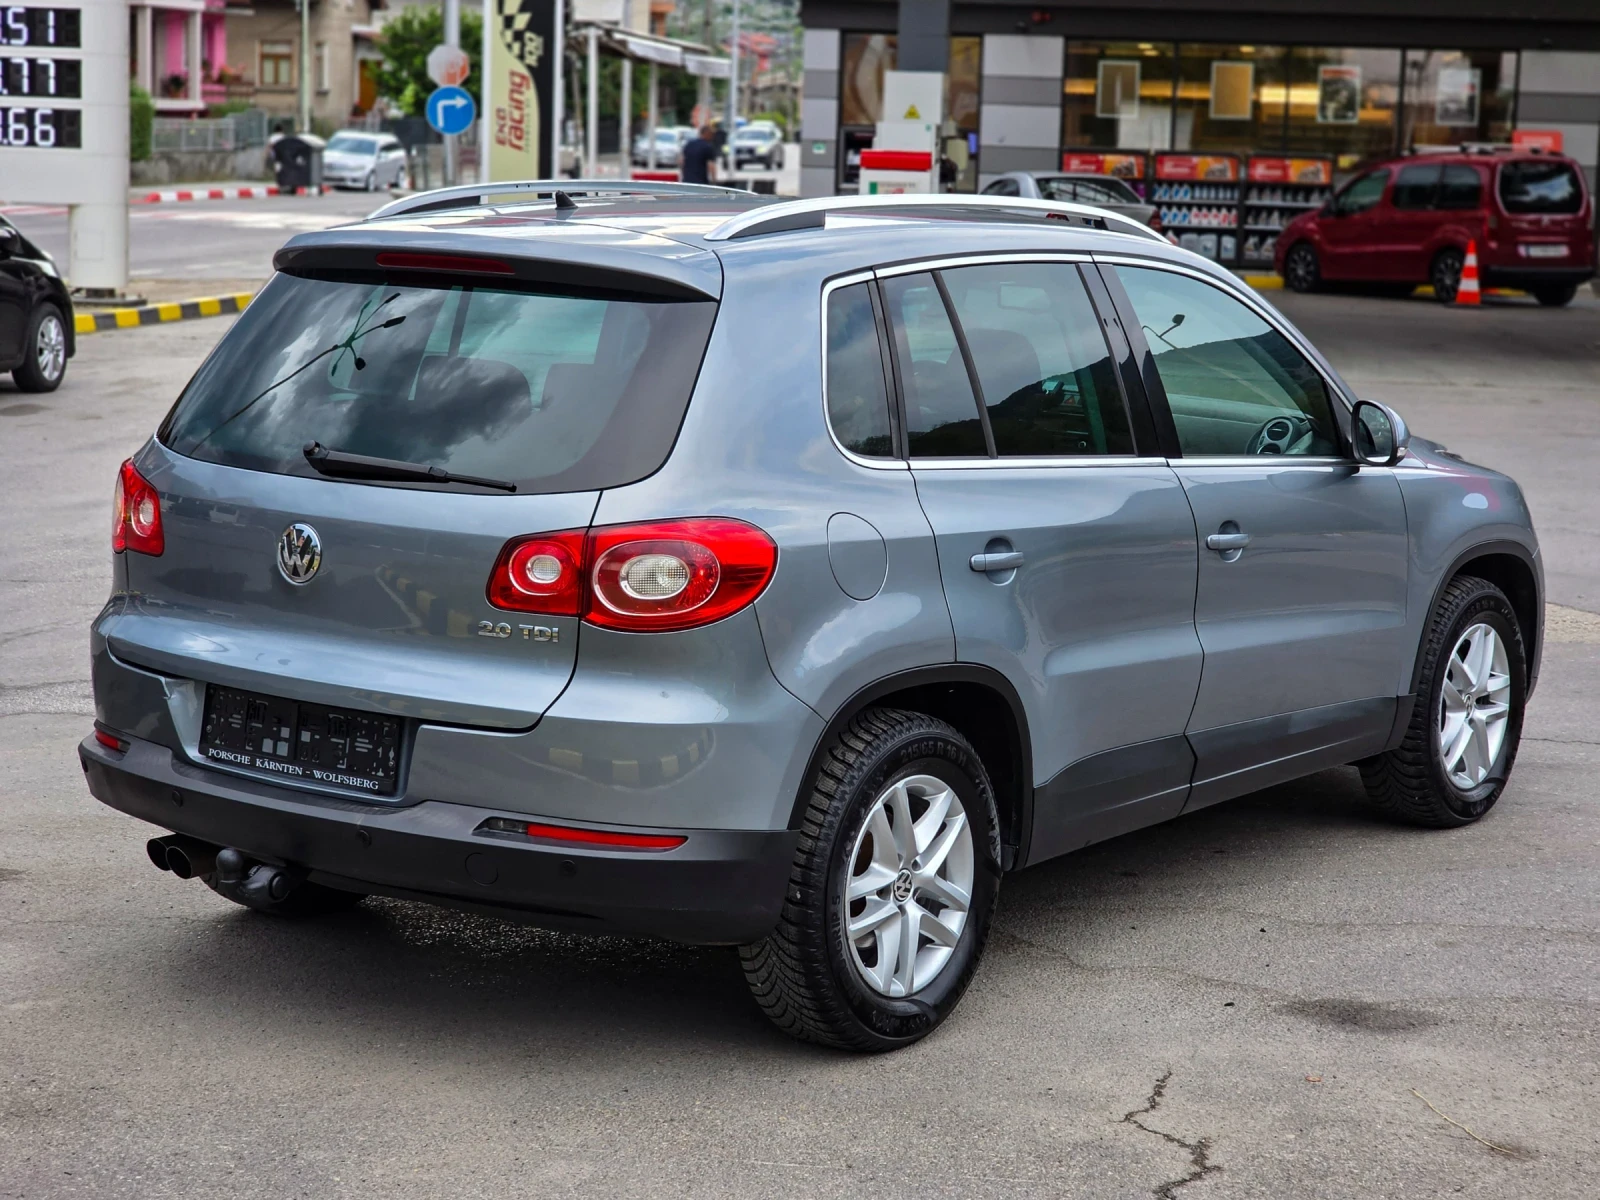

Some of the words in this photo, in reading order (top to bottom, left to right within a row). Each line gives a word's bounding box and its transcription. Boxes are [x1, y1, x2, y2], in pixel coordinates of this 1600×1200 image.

[0, 7, 55, 46] .51
[0, 57, 56, 95] .77
[0, 107, 56, 146] .66
[508, 70, 531, 152] racing
[518, 624, 559, 643] TDI
[208, 747, 251, 765] PORSCHE
[256, 758, 303, 775] KÄRNTEN
[312, 769, 379, 790] WOLFSBERG
[900, 741, 935, 764] 215/65
[936, 741, 945, 756] R
[946, 744, 957, 760] 16
